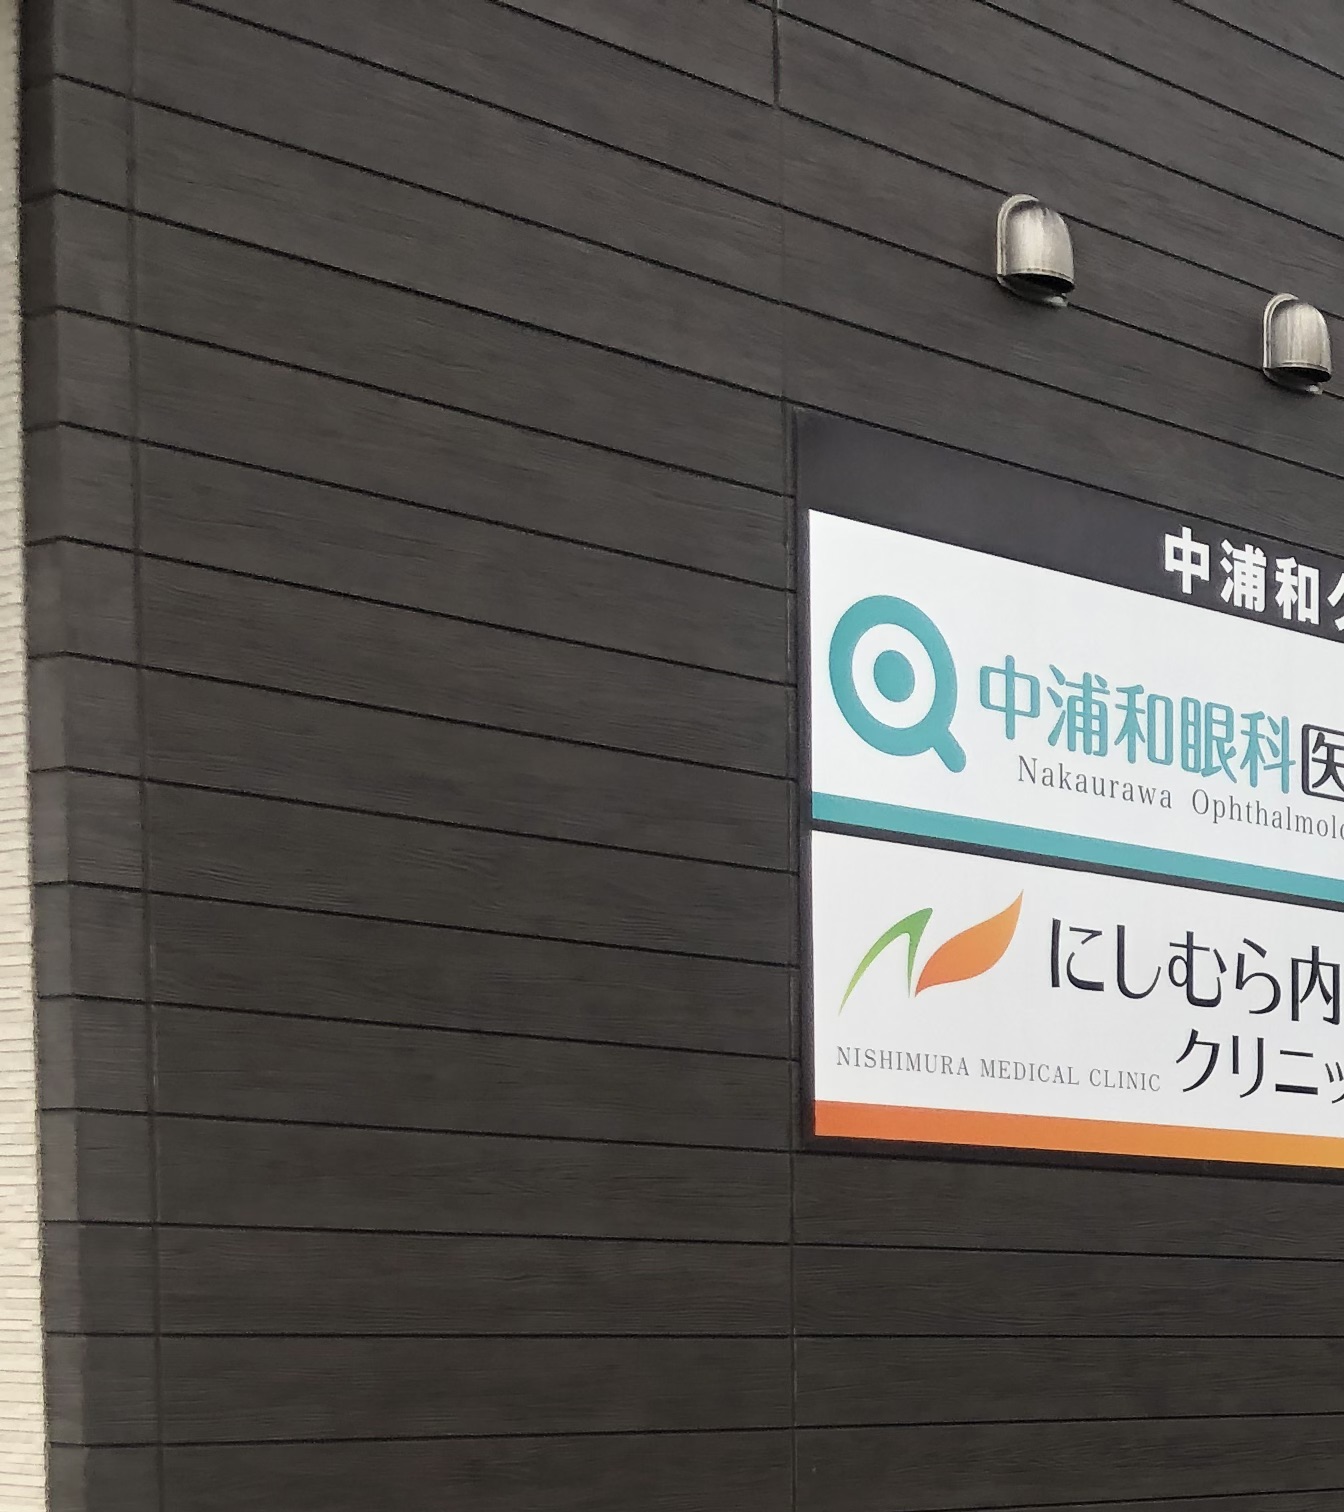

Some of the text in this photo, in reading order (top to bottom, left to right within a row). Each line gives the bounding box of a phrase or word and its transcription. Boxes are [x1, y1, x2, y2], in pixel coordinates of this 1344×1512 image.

[1018, 755, 1172, 809] Nakaurawa
[836, 1045, 1162, 1092] NISHIMURA MEDICAL CLINIC
